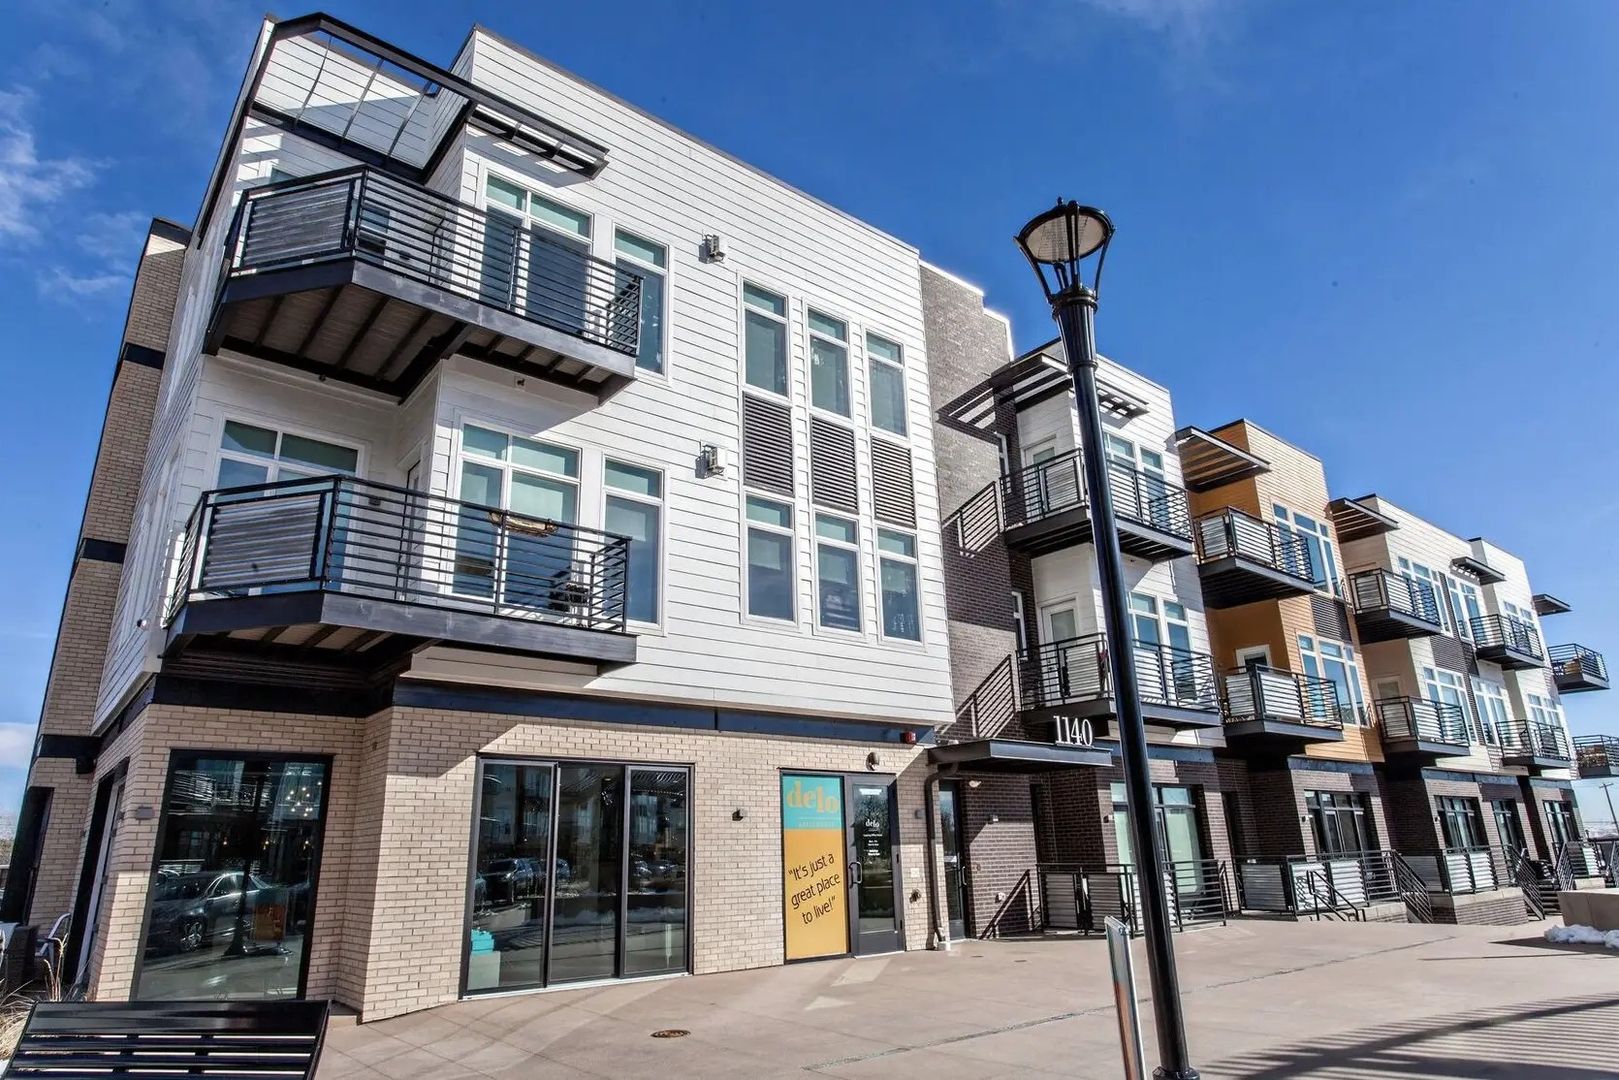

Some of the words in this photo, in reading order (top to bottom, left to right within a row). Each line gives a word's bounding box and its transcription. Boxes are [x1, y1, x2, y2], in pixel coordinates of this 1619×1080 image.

[1053, 715, 1093, 746] 1140
[786, 779, 840, 813] delo
[809, 855, 827, 877] just
[828, 853, 835, 864] a
[791, 885, 816, 910] great
[816, 873, 841, 896] place
[802, 912, 813, 924] to
